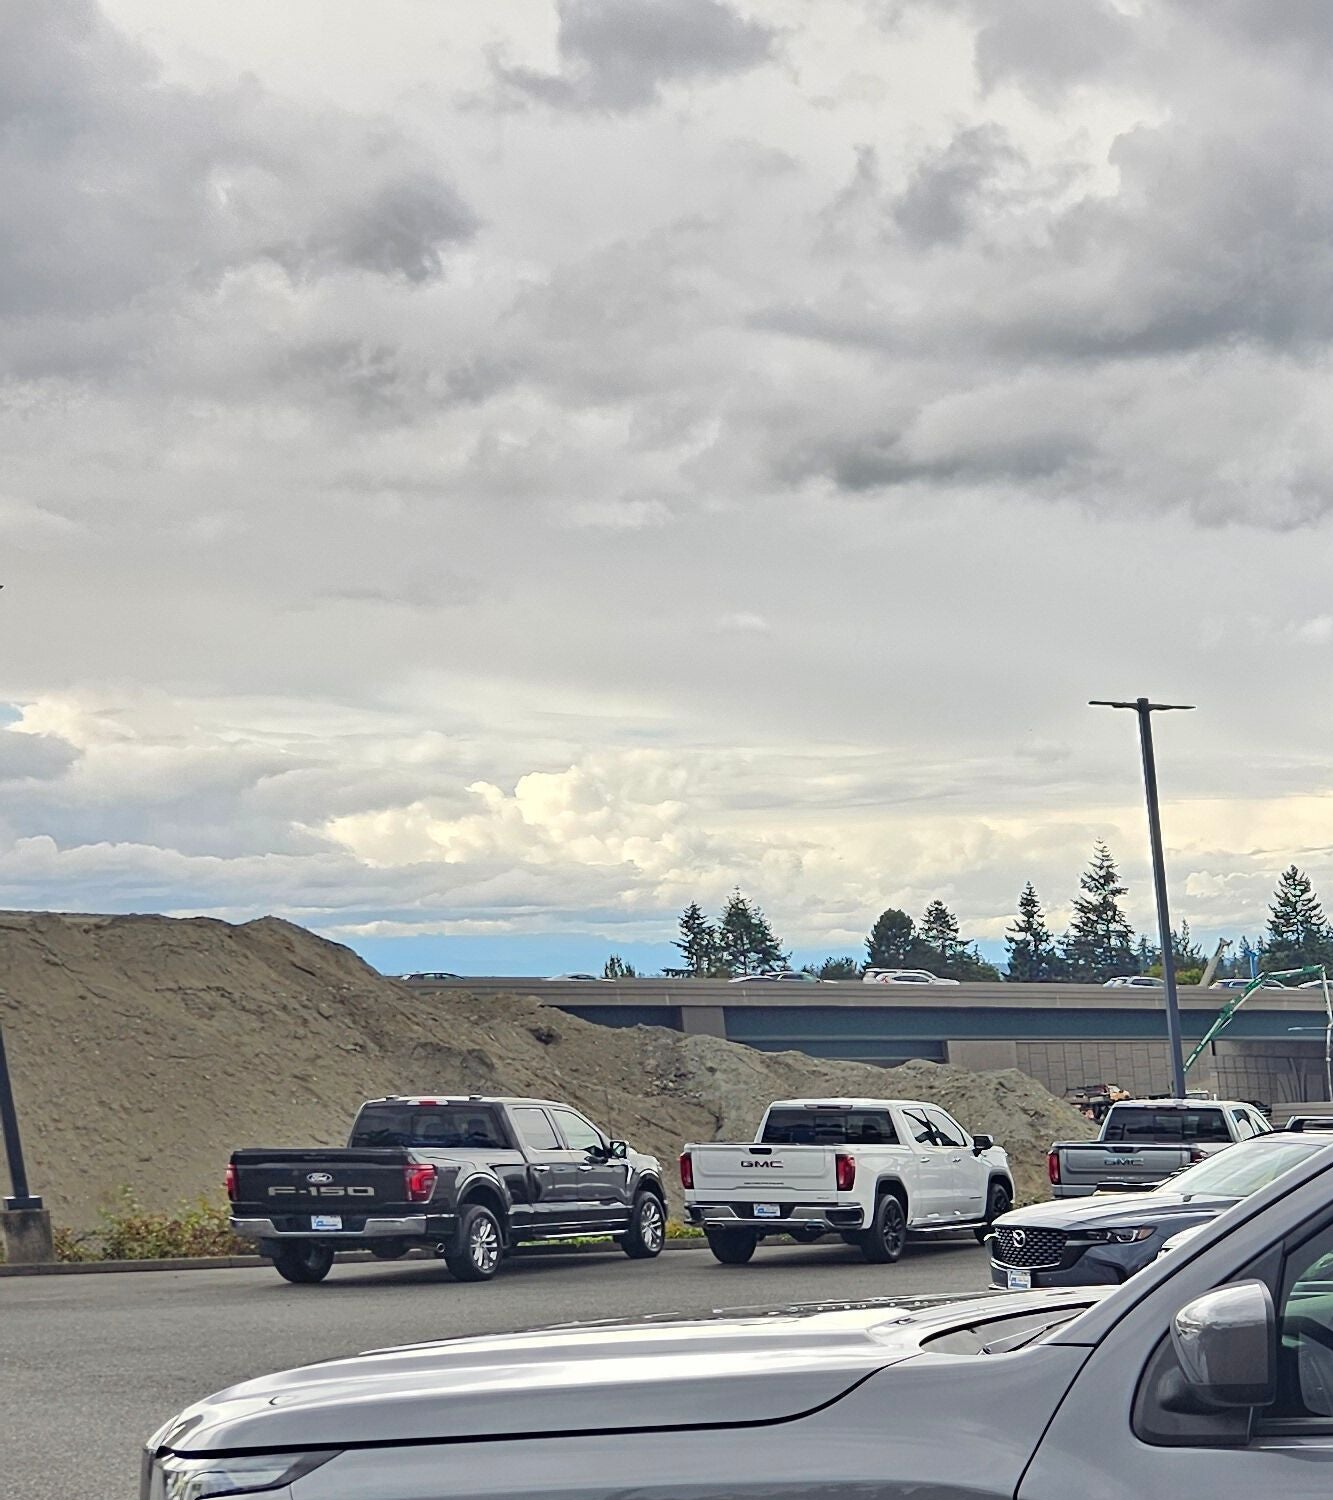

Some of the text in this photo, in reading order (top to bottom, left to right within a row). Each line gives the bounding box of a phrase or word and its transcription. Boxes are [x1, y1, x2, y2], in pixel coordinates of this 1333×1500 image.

[740, 1160, 784, 1168] GMC
[1104, 1157, 1145, 1166] GMC
[267, 1186, 375, 1196] F-150
